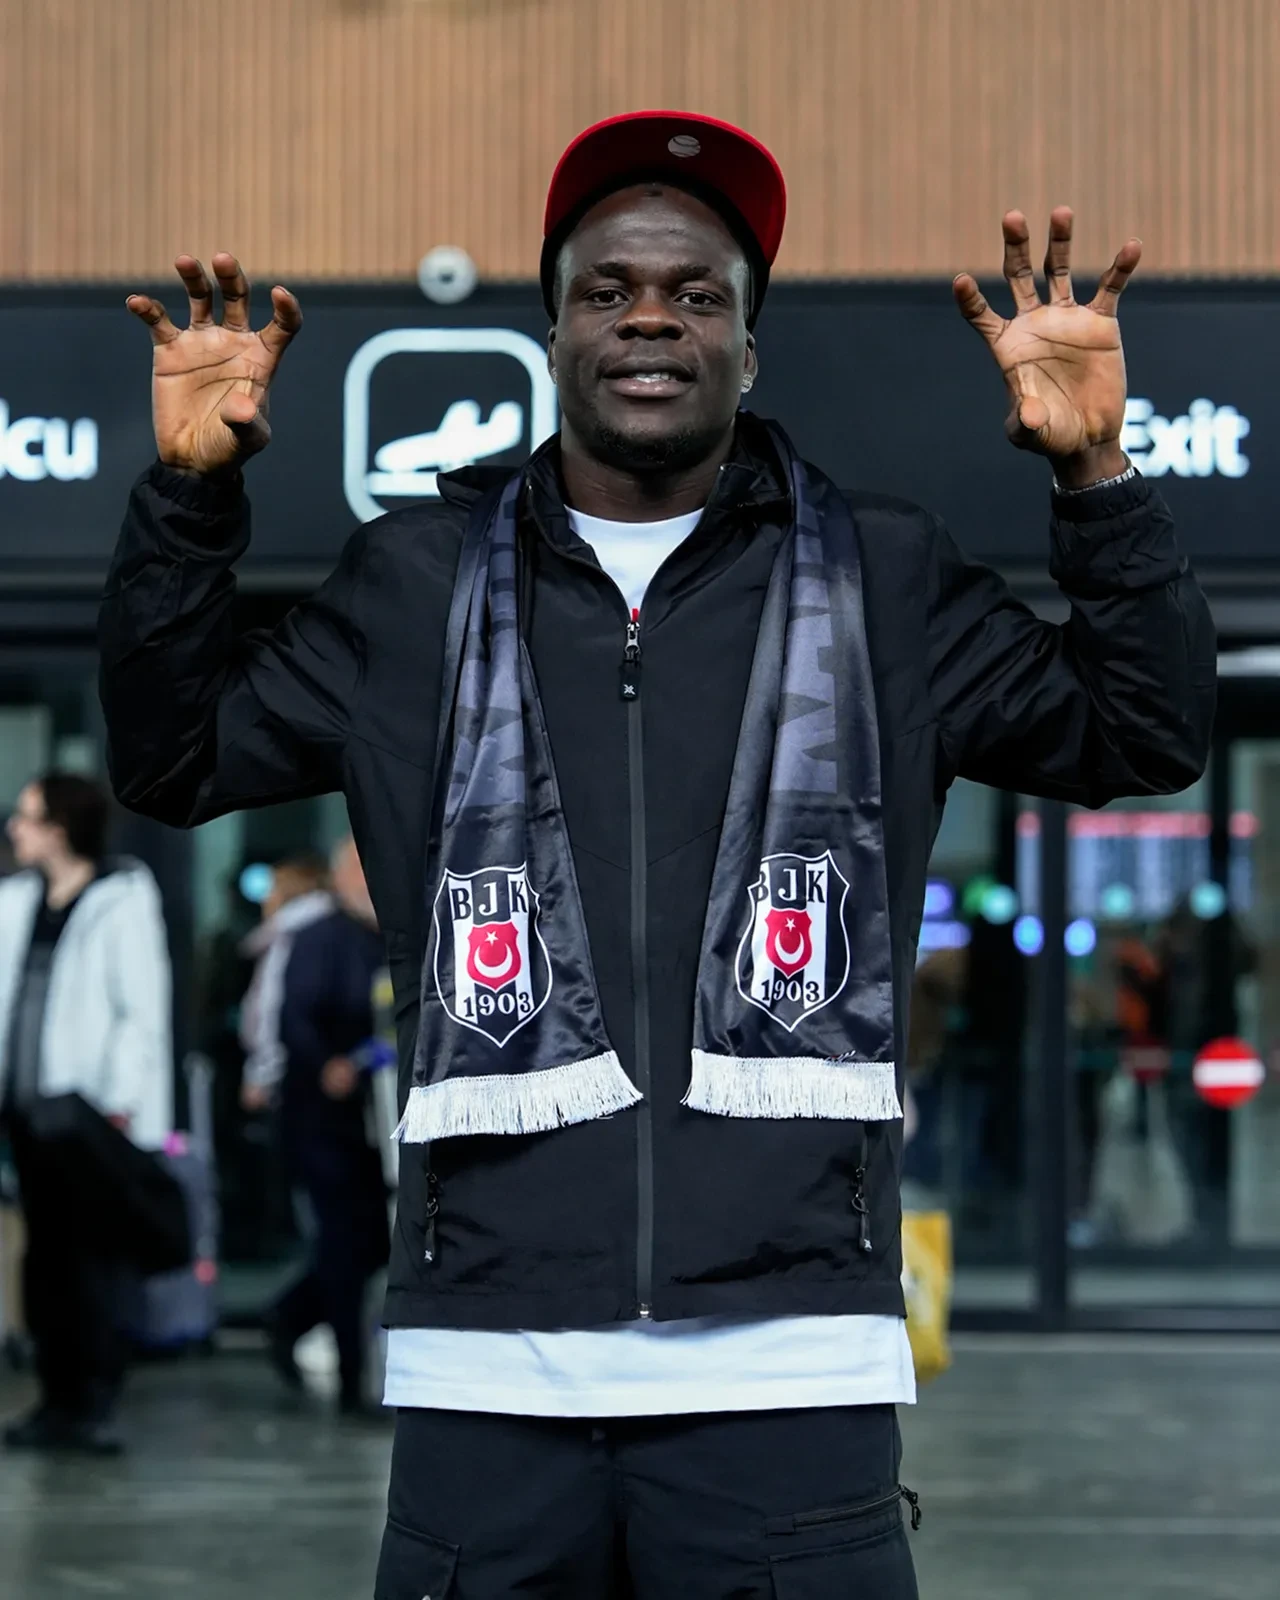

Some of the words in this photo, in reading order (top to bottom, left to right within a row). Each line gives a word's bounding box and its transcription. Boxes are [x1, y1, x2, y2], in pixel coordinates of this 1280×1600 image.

[1120, 398, 1250, 477] Exit
[450, 880, 529, 921] BJK
[753, 868, 826, 904] BJK
[463, 992, 532, 1018] 1903
[761, 979, 820, 1003] 1903
